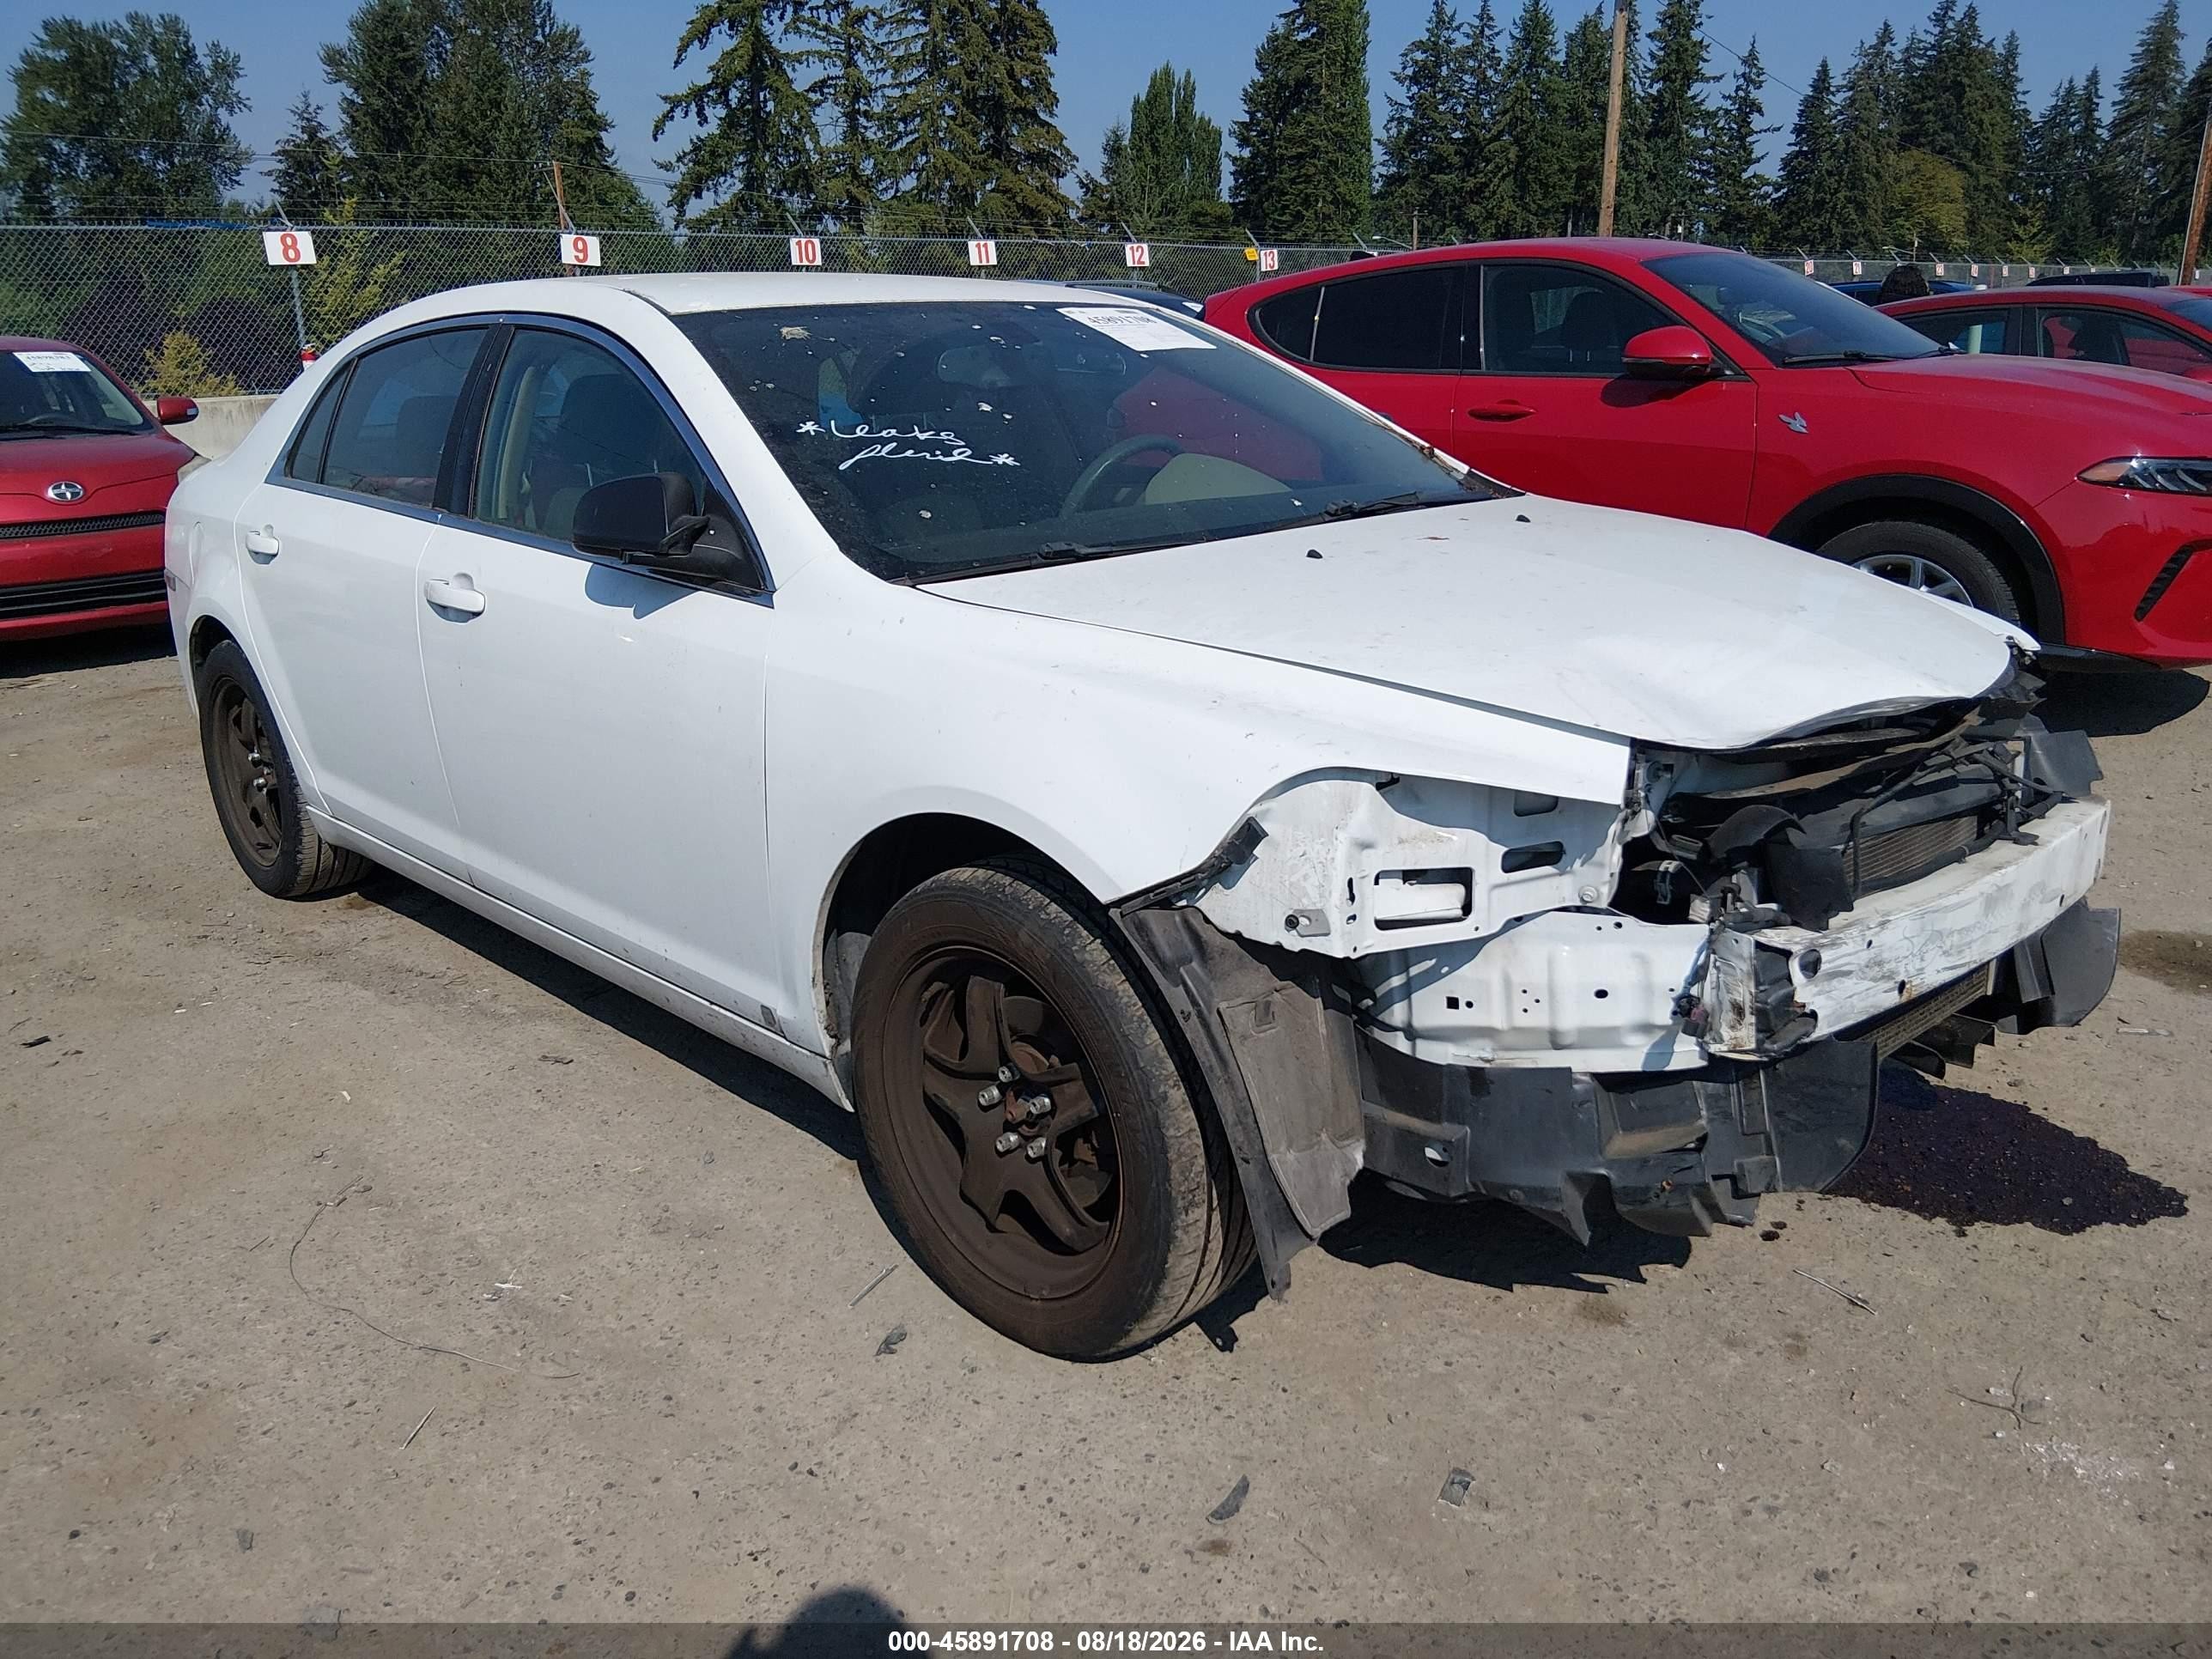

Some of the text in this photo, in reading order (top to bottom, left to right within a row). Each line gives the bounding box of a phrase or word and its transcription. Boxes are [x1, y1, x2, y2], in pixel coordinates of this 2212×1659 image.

[280, 233, 301, 263] 8
[572, 236, 589, 264] 9
[796, 239, 817, 264] 10
[975, 242, 990, 264] 11
[1129, 246, 1146, 265] 12
[1263, 250, 1275, 270] 13
